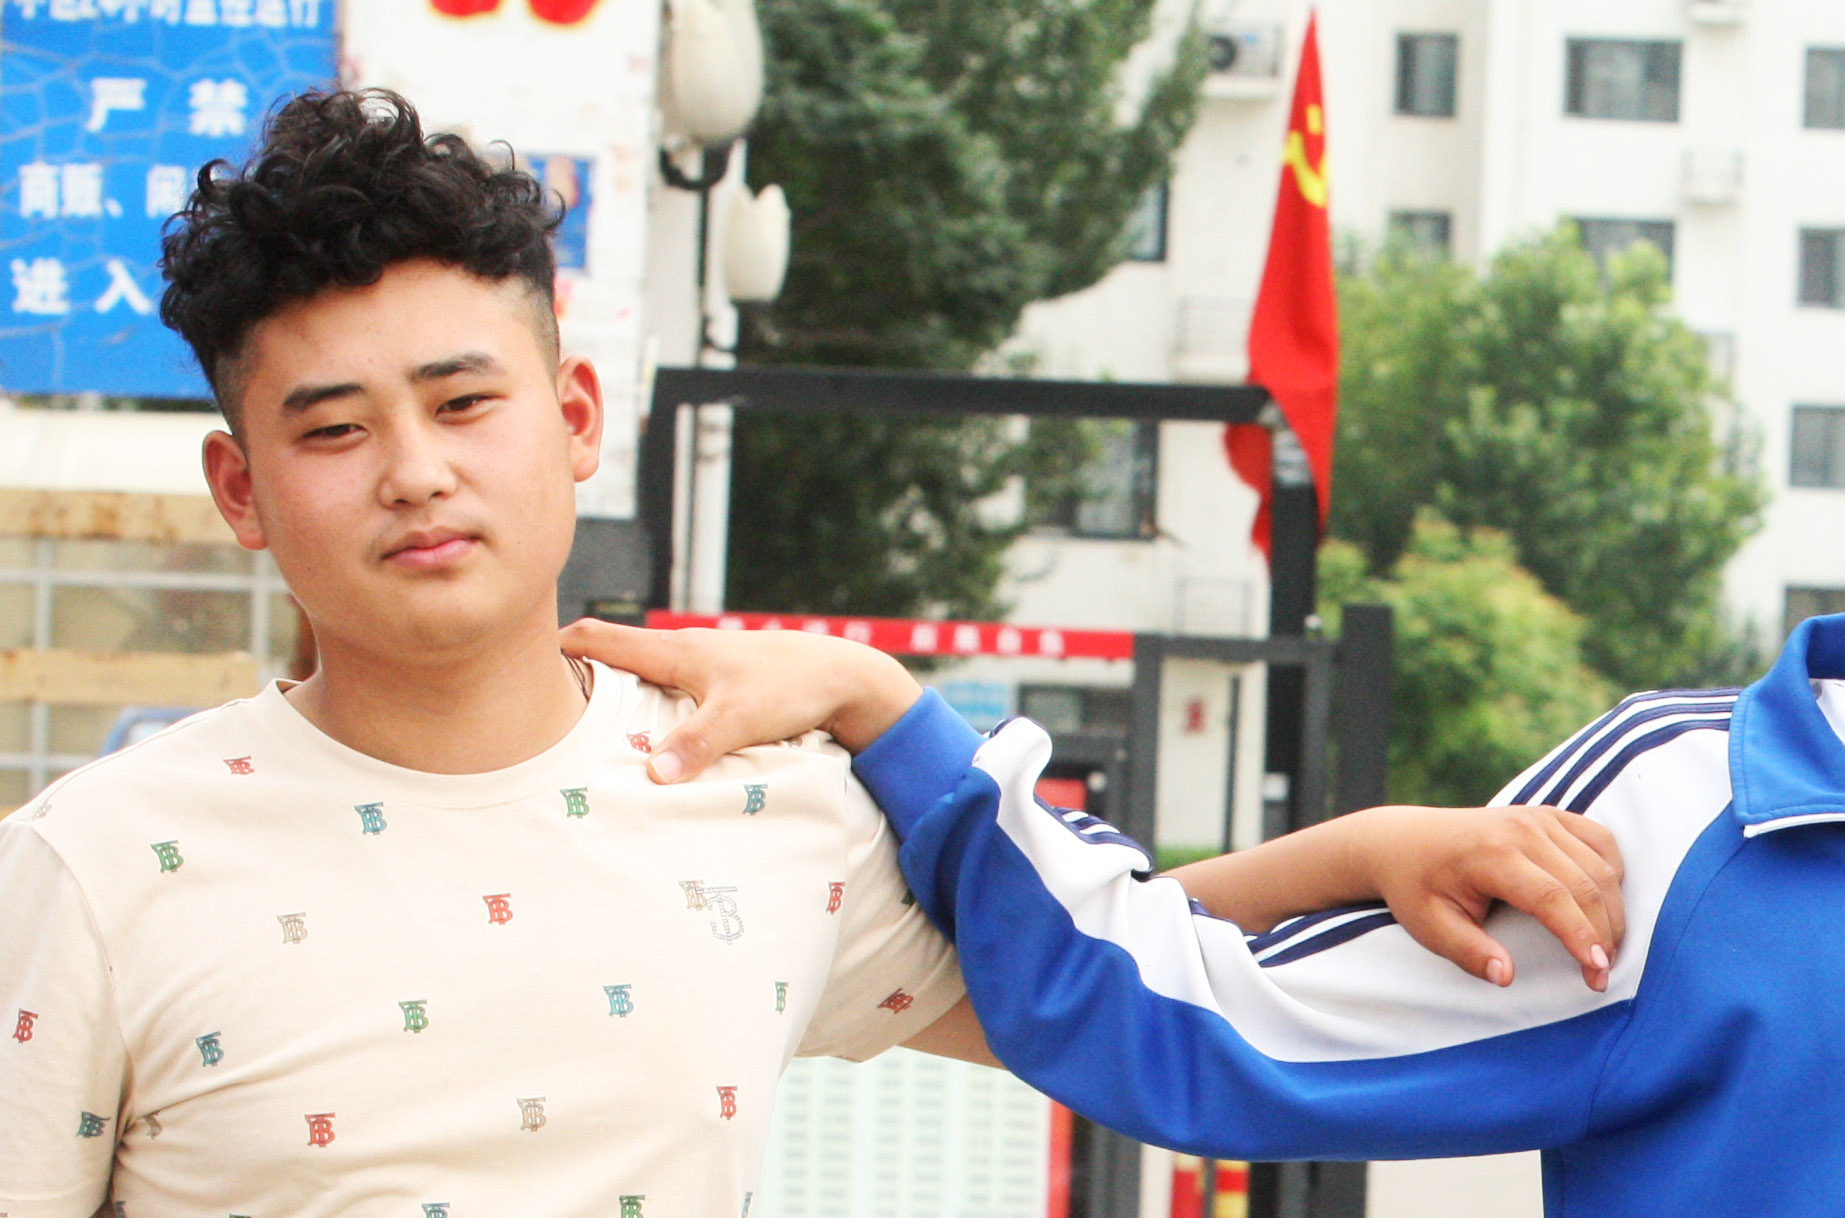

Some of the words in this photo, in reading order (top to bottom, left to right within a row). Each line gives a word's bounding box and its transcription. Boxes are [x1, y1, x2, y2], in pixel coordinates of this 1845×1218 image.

[85, 77, 249, 138] 严禁
[18, 160, 198, 219] 商贩、闲
[9, 256, 154, 316] 进入
